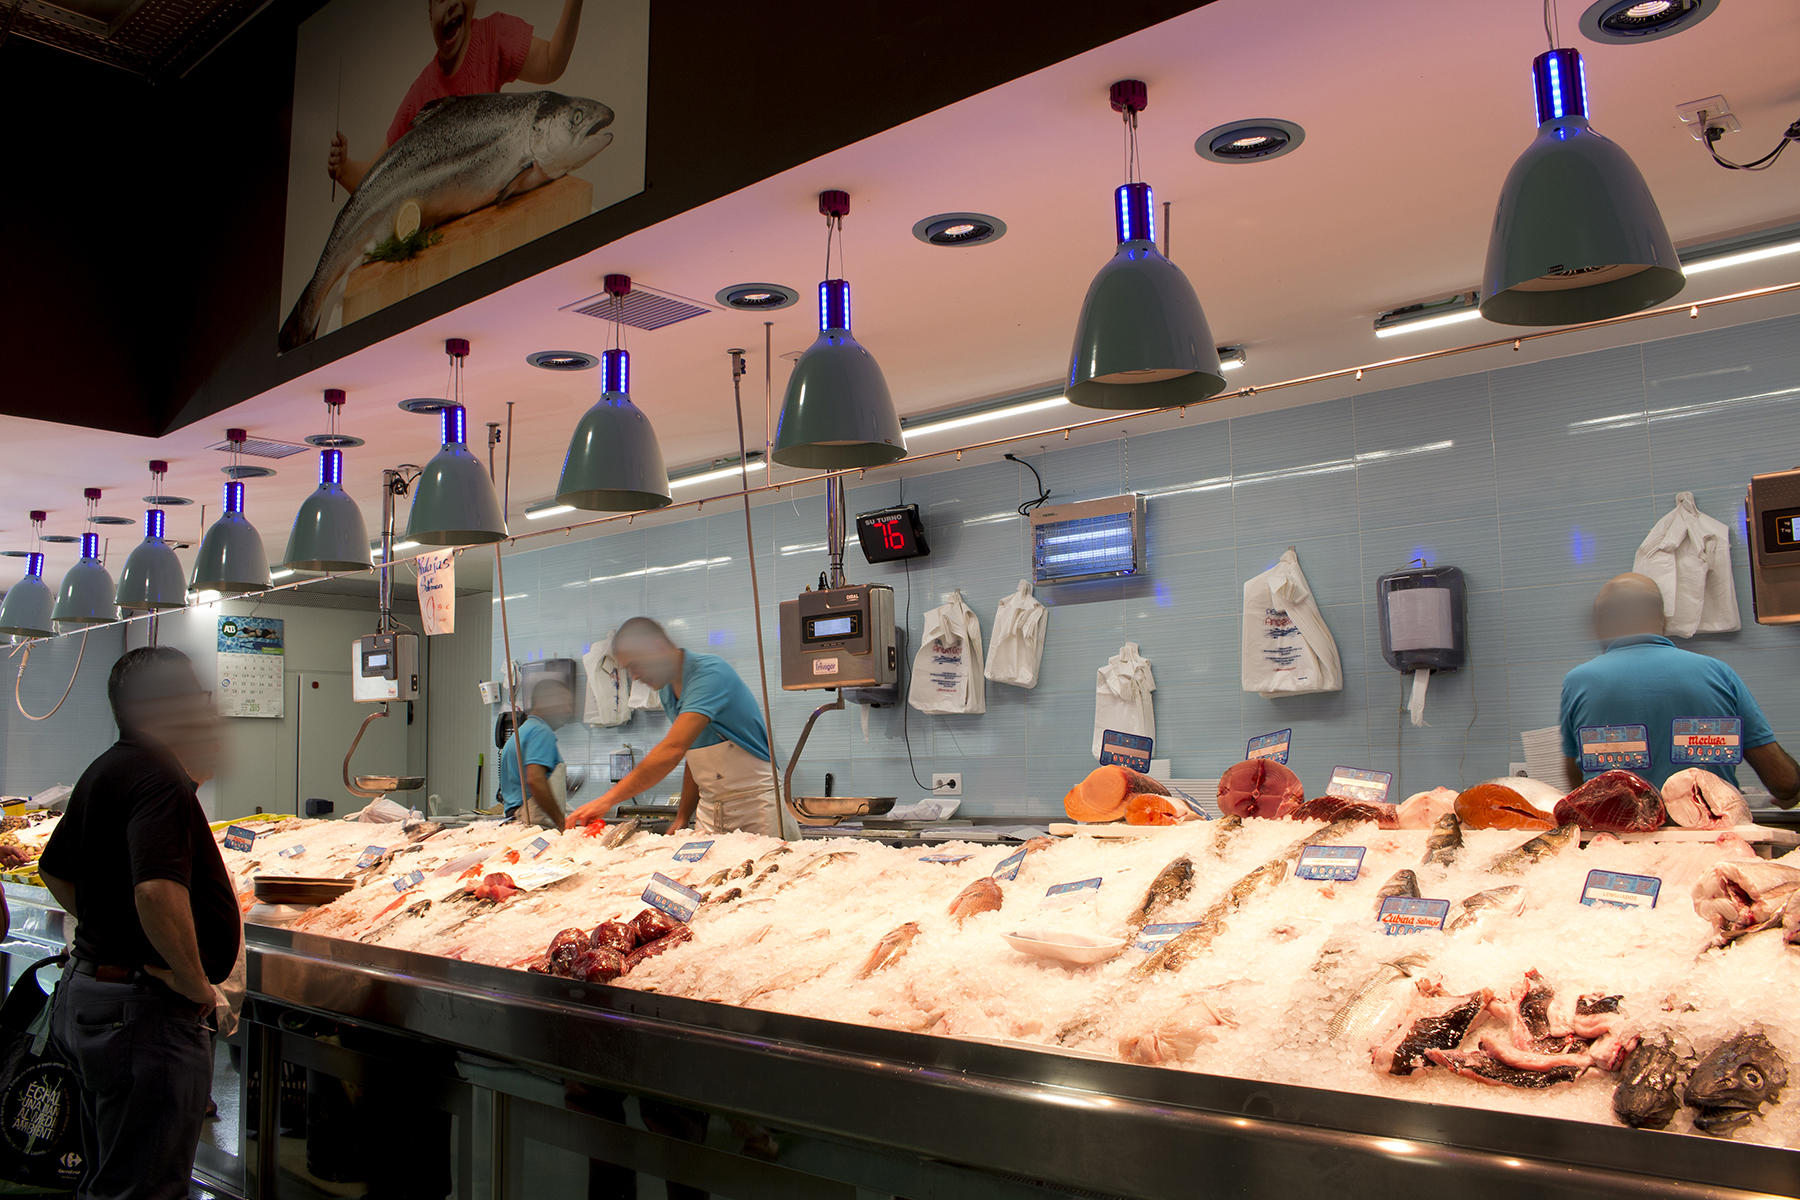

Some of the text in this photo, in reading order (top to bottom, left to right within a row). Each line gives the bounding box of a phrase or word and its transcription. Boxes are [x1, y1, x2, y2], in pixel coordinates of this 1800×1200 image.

[876, 514, 902, 524] TURNO
[873, 519, 905, 550] 76
[1688, 735, 1727, 746] Merluza
[1602, 891, 1638, 901] LENGUADOS
[21, 1096, 42, 1112] UNA
[17, 1107, 30, 1121] AL
